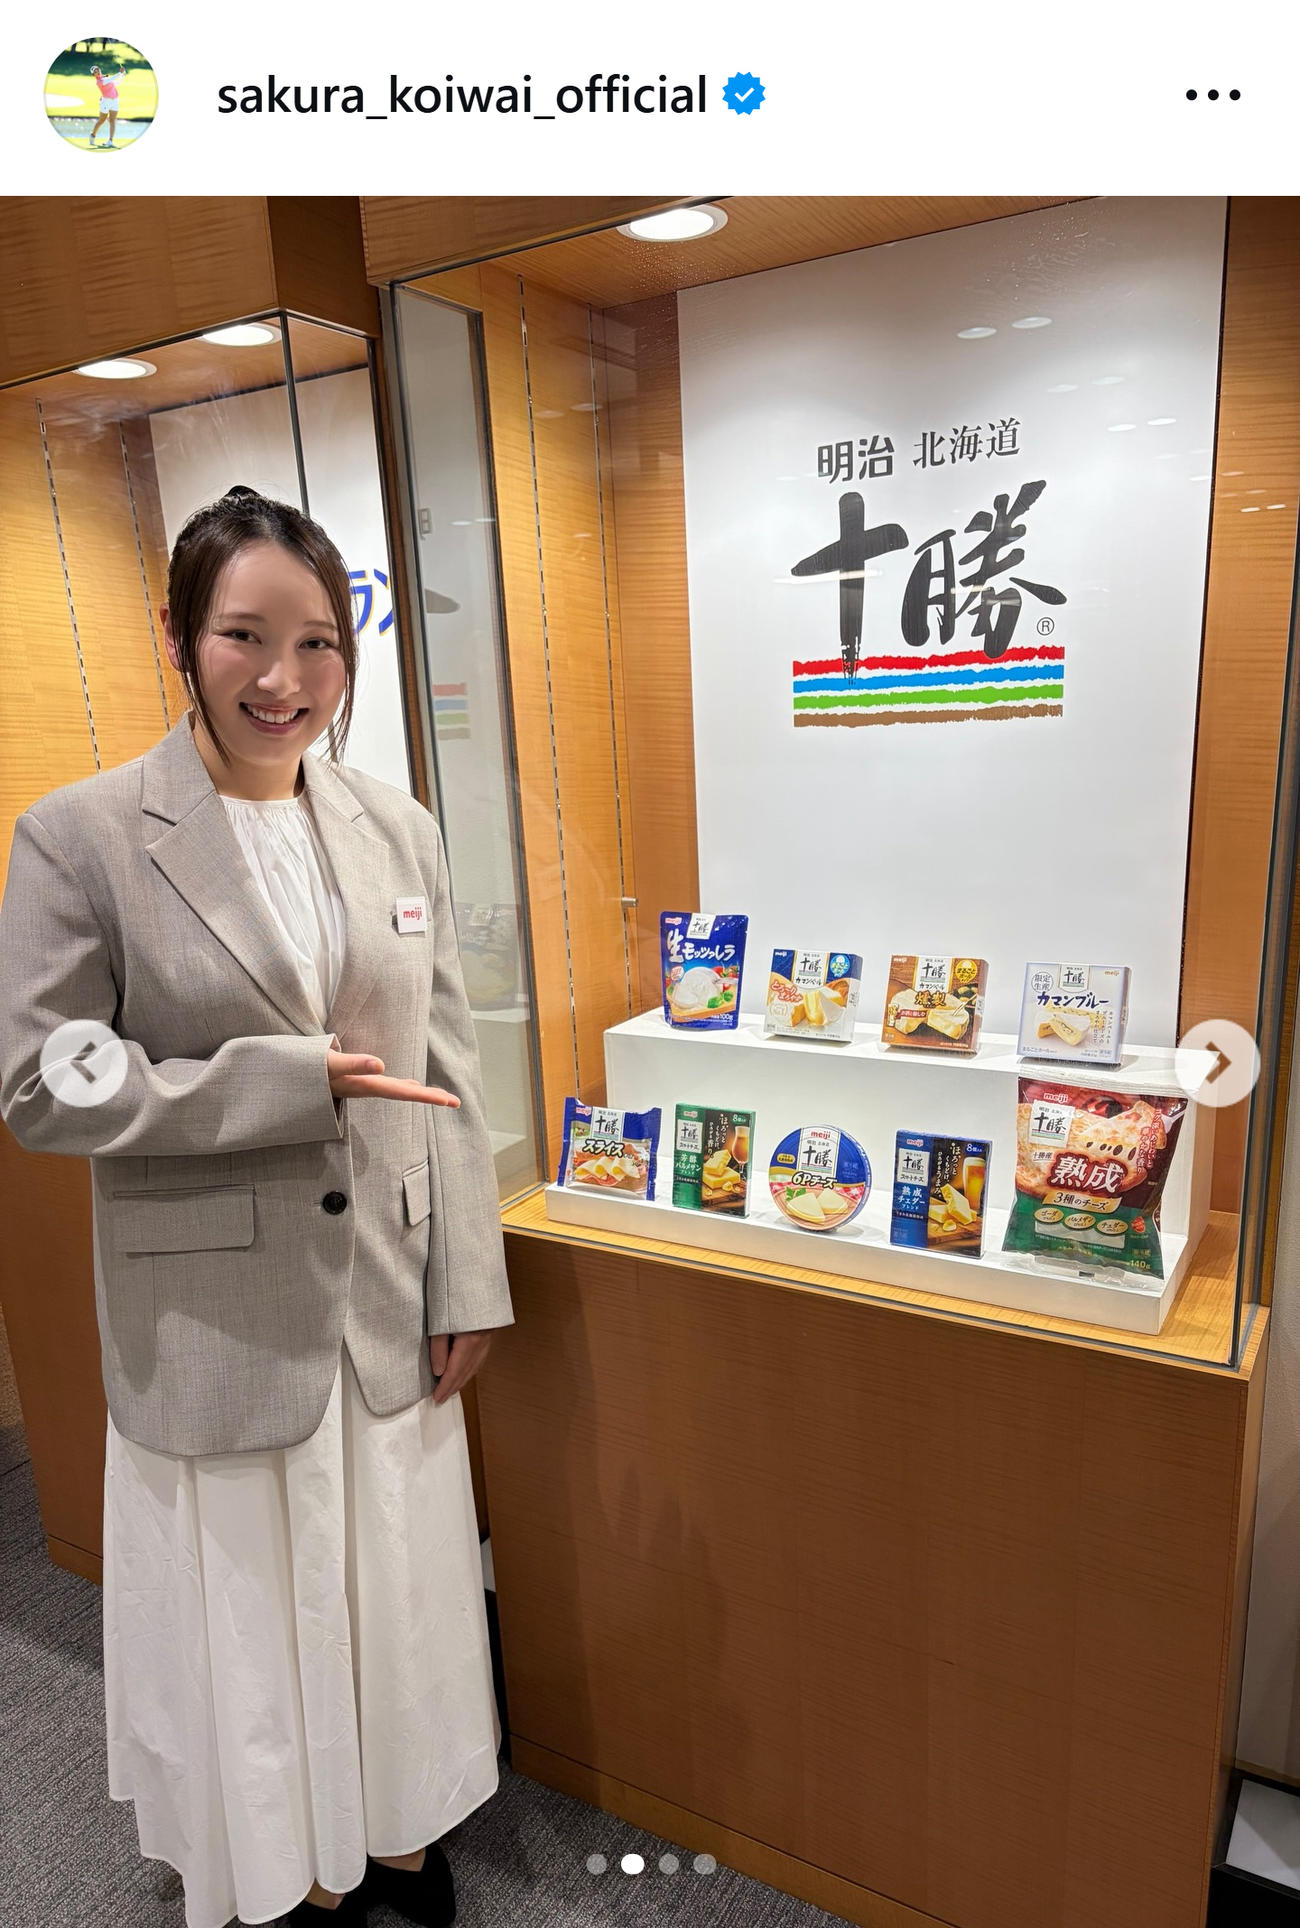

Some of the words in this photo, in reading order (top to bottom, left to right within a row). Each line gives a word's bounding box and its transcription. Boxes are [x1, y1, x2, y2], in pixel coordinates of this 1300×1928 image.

[817, 434, 895, 484] 明治
[912, 416, 1022, 470] 北海道
[790, 479, 1068, 686] 十勝
[402, 906, 423, 921] meiji
[800, 957, 822, 972] 十勝
[922, 962, 946, 978] 十勝
[1064, 970, 1085, 983] 十勝
[1037, 991, 1109, 1009] カマンブルー
[1044, 1092, 1068, 1103] meiji
[595, 1115, 619, 1134] 十勝
[1034, 1111, 1067, 1134] 十勝
[811, 1131, 831, 1139] meiji
[582, 1139, 624, 1157] スライス
[803, 1145, 833, 1167] 十勝
[904, 1155, 924, 1170] 十勝
[792, 1171, 837, 1189] 6Pチーズ
[1050, 1156, 1125, 1193] 熟成
[902, 1185, 922, 1198] 熟成
[898, 1196, 925, 1206] チェダー
[1054, 1192, 1110, 1210] 3種のチーズ
